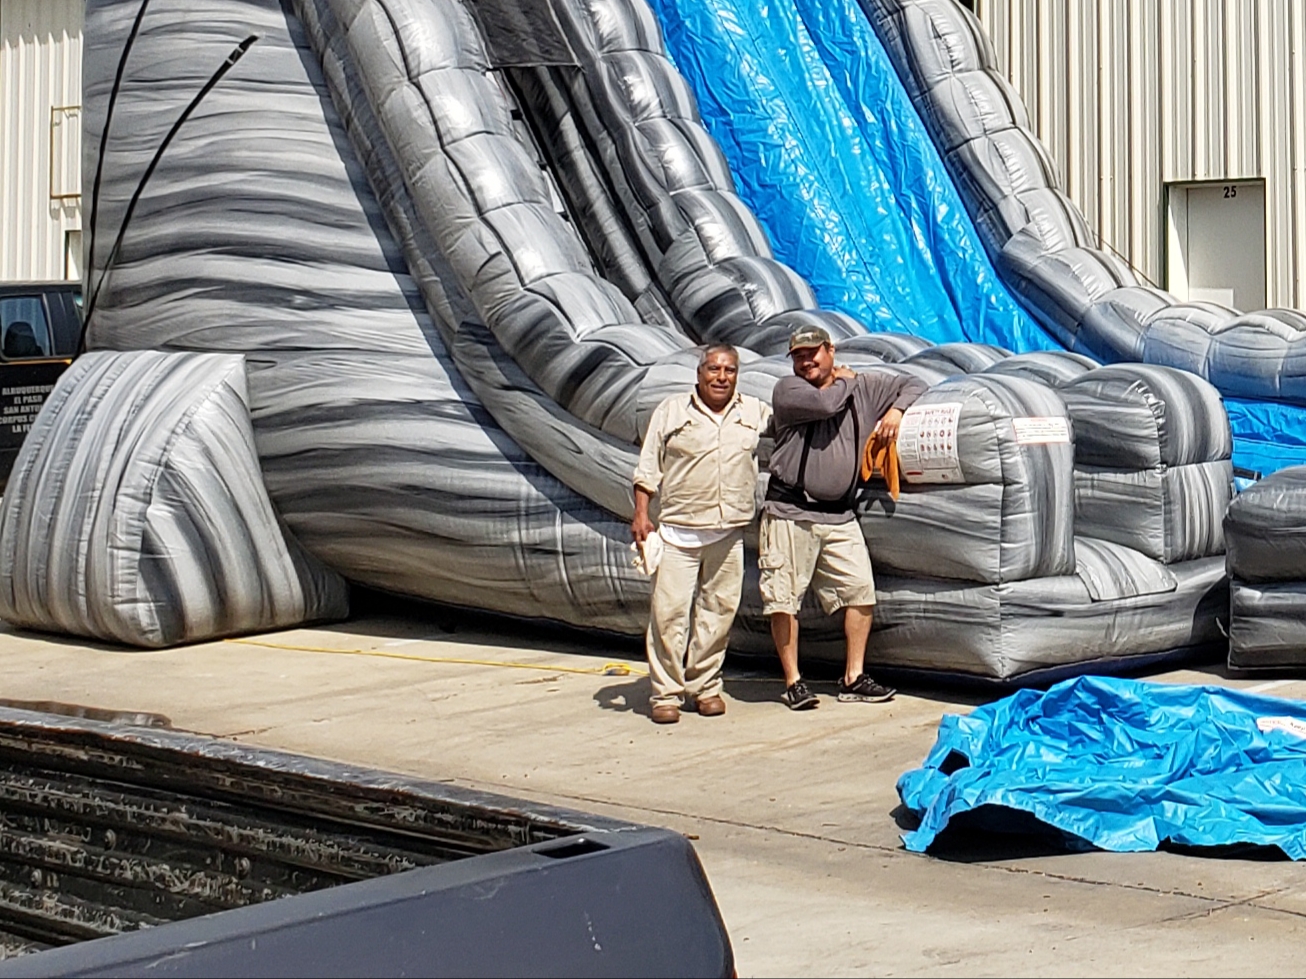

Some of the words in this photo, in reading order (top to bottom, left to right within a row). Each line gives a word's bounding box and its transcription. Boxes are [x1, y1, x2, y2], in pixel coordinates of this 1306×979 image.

[1223, 185, 1237, 198] 25
[22, 395, 43, 404] PASO
[3, 406, 19, 414] SAN
